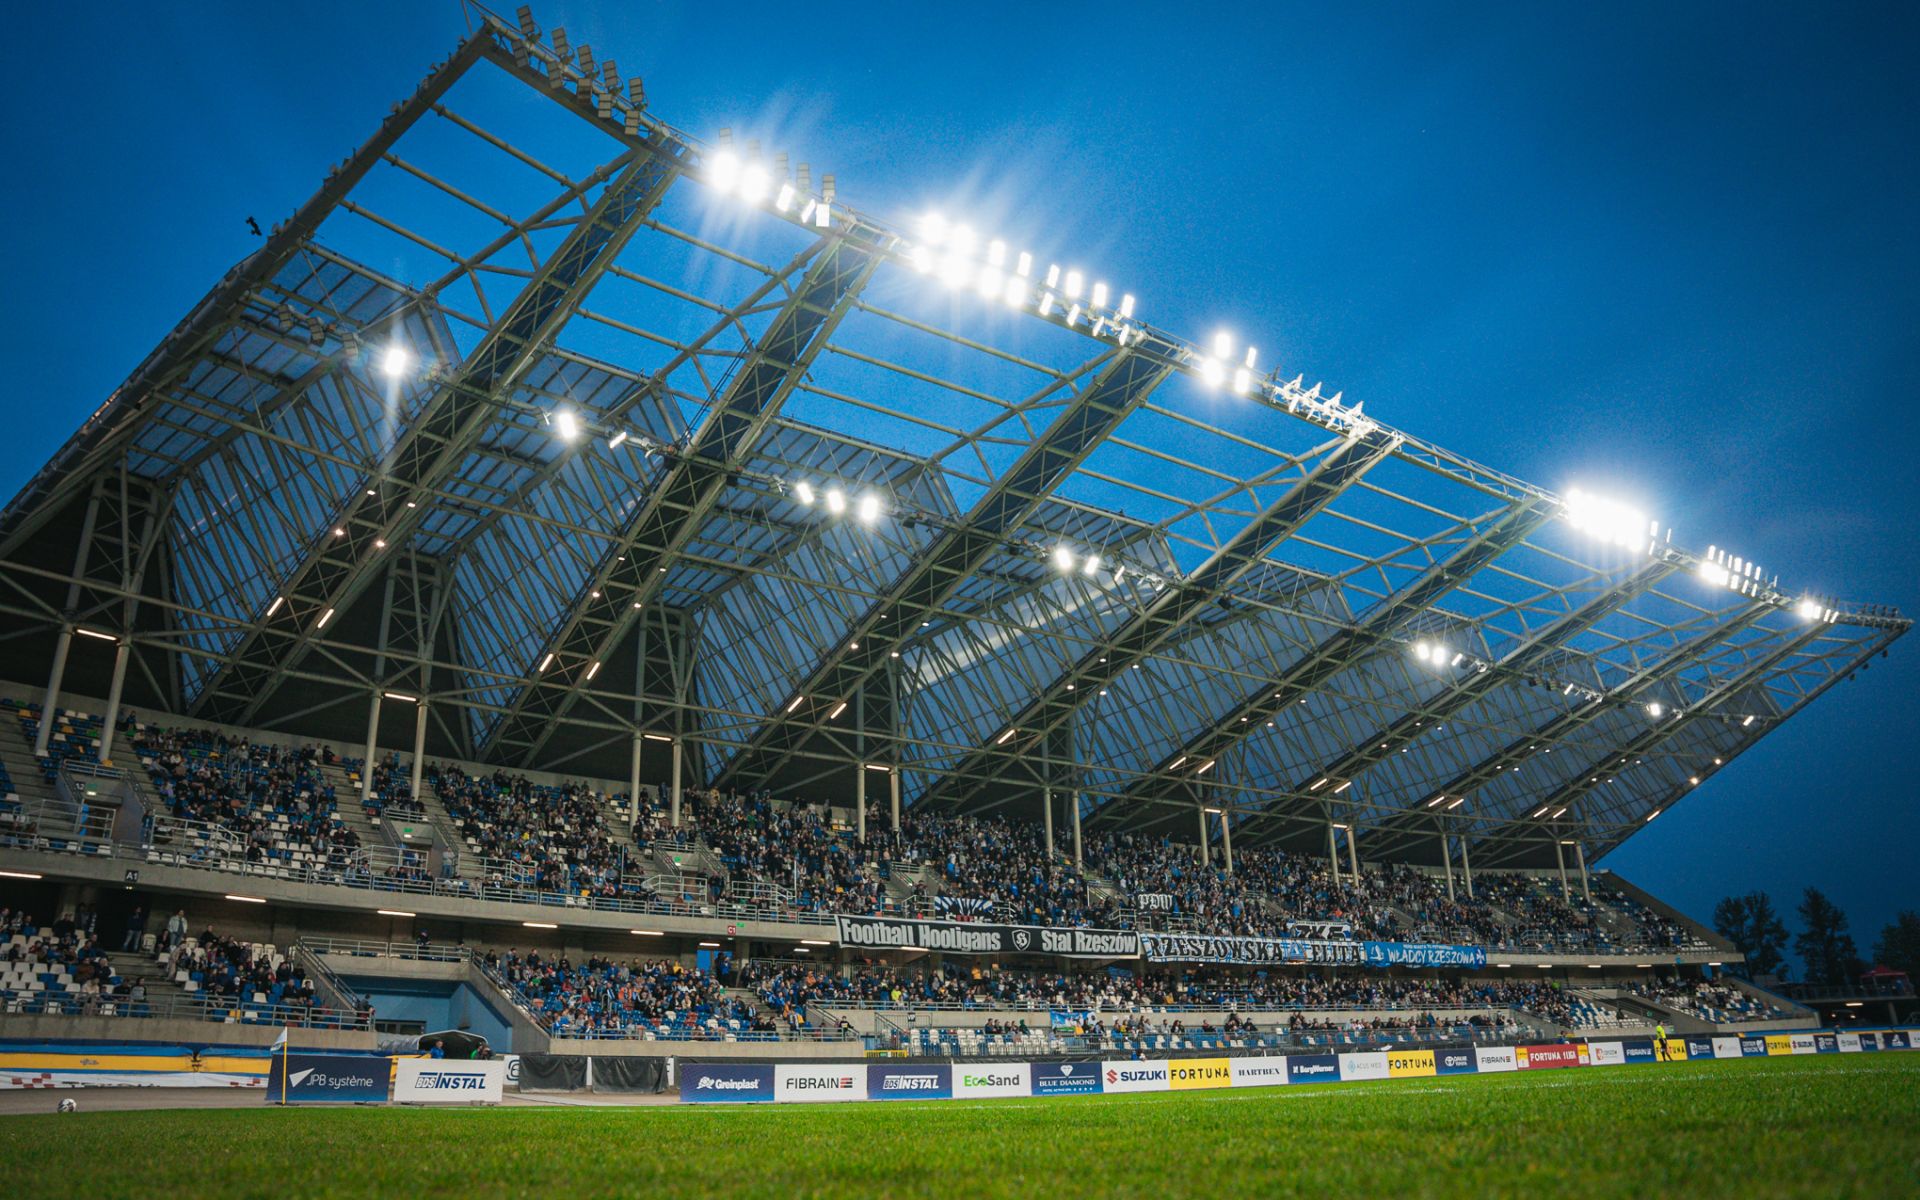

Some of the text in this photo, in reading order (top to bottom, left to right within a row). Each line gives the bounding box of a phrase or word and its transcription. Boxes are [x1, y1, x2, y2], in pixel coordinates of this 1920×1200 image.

[126, 871, 138, 880] A1
[728, 926, 736, 934] C1
[840, 917, 1001, 951] Football Hooligans
[1041, 929, 1136, 953] Stal Rzeszów
[1530, 1051, 1562, 1062] FORTUNA
[1388, 1058, 1434, 1070] FORTUNA
[1120, 1070, 1166, 1082] SUZUKI
[1171, 1067, 1230, 1080] FORTUNA
[306, 1073, 374, 1089] JPB système
[786, 1077, 839, 1089] FIBRAIN
[964, 1074, 1020, 1087] EcoSand
